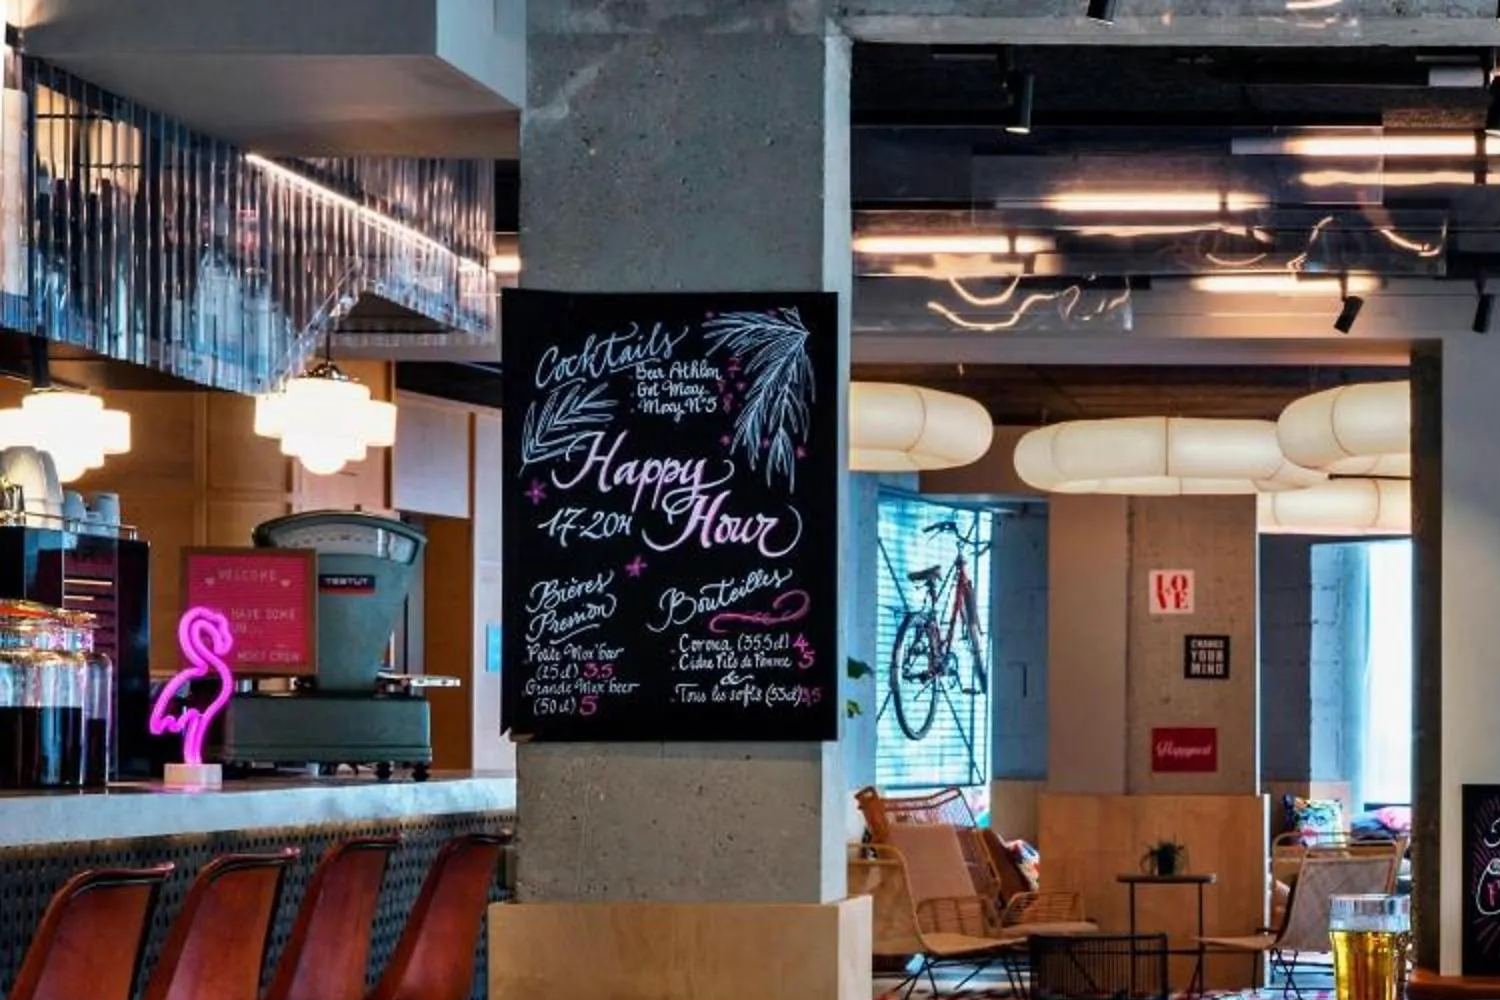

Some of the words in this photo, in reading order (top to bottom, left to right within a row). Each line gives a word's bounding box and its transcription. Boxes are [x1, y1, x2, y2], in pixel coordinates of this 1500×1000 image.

[535, 321, 689, 388] Cocktails
[551, 429, 735, 525] Happy
[641, 489, 803, 558] Hour
[525, 569, 615, 612] Bières
[647, 568, 794, 633] Bouteilles
[1190, 650, 1225, 662] YOUR
[1190, 662, 1225, 676] MIND
[579, 695, 600, 715] 5
